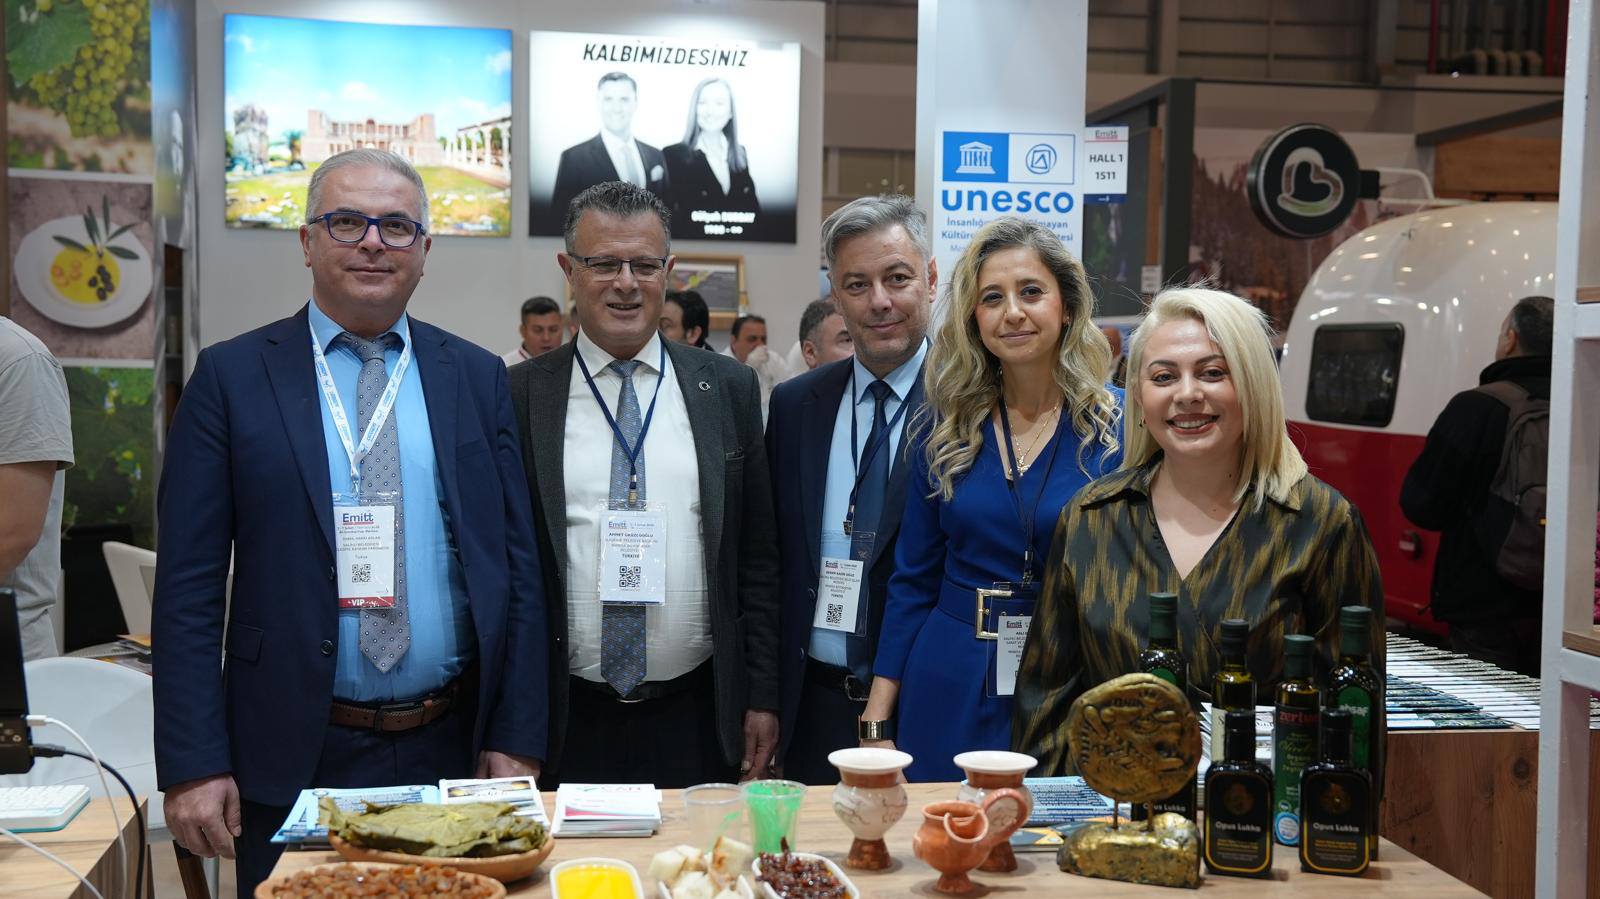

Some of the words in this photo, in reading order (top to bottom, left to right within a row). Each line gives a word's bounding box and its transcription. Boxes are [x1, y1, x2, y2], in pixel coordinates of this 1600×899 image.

[583, 40, 749, 67] KALBİMİZDESİNİZ
[1089, 154, 1115, 163] HALL
[1118, 154, 1124, 163] 1
[1095, 171, 1117, 180] 1511
[941, 189, 1075, 214] unesco
[946, 215, 985, 228] İnsanlığ
[342, 512, 375, 523] Emitt
[351, 599, 365, 607] VIP
[1142, 802, 1163, 813] Ous
[1215, 821, 1236, 832] Opus
[1237, 822, 1261, 833] Lukka
[1312, 821, 1334, 832] Opus
[1335, 822, 1360, 833] Lukka
